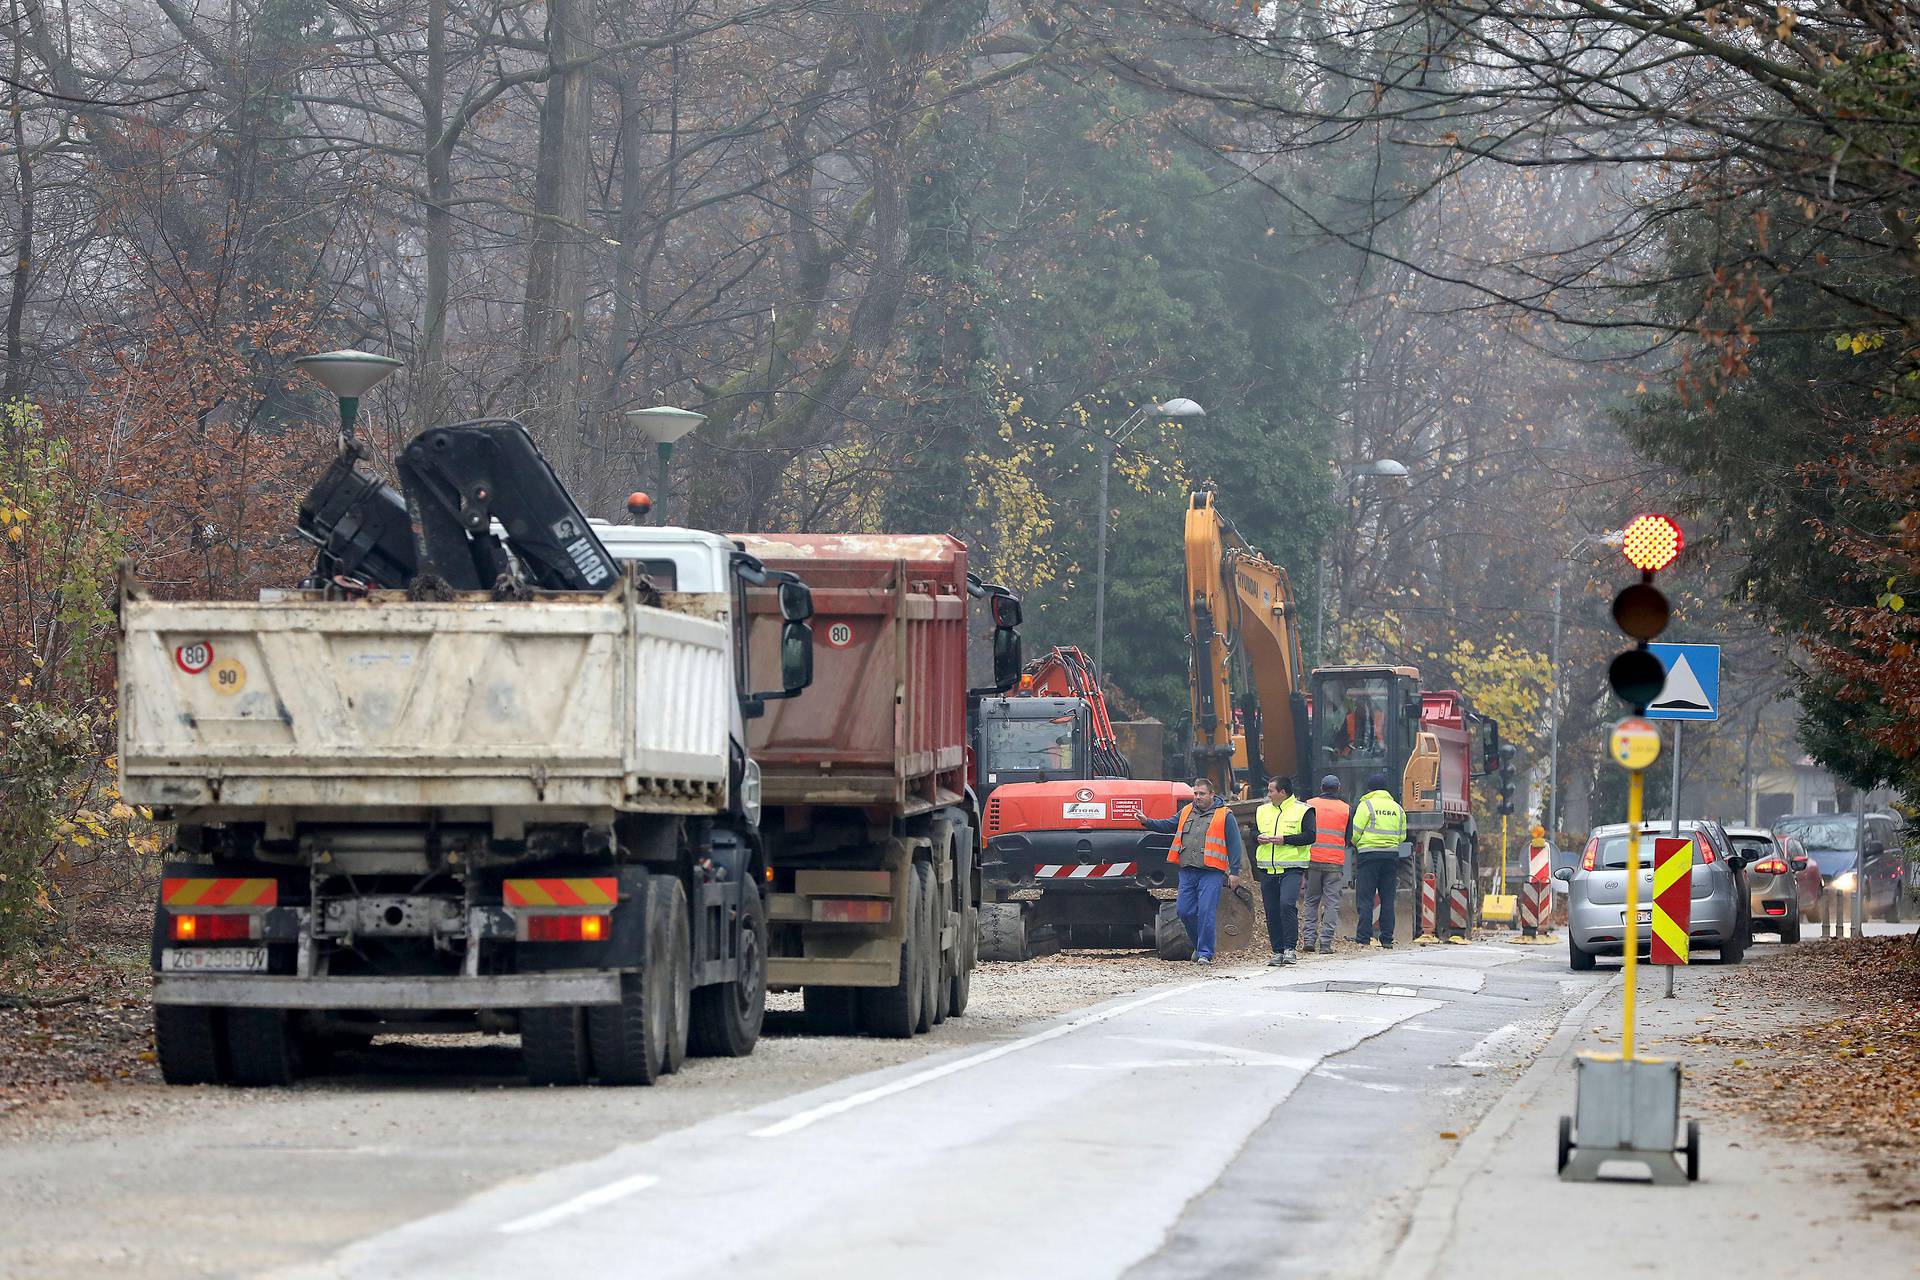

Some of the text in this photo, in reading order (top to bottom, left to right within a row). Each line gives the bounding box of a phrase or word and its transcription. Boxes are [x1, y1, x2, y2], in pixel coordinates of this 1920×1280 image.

[566, 537, 608, 585] HIAB
[832, 627, 848, 641] 80
[185, 646, 205, 664] 80
[218, 670, 236, 684] 90
